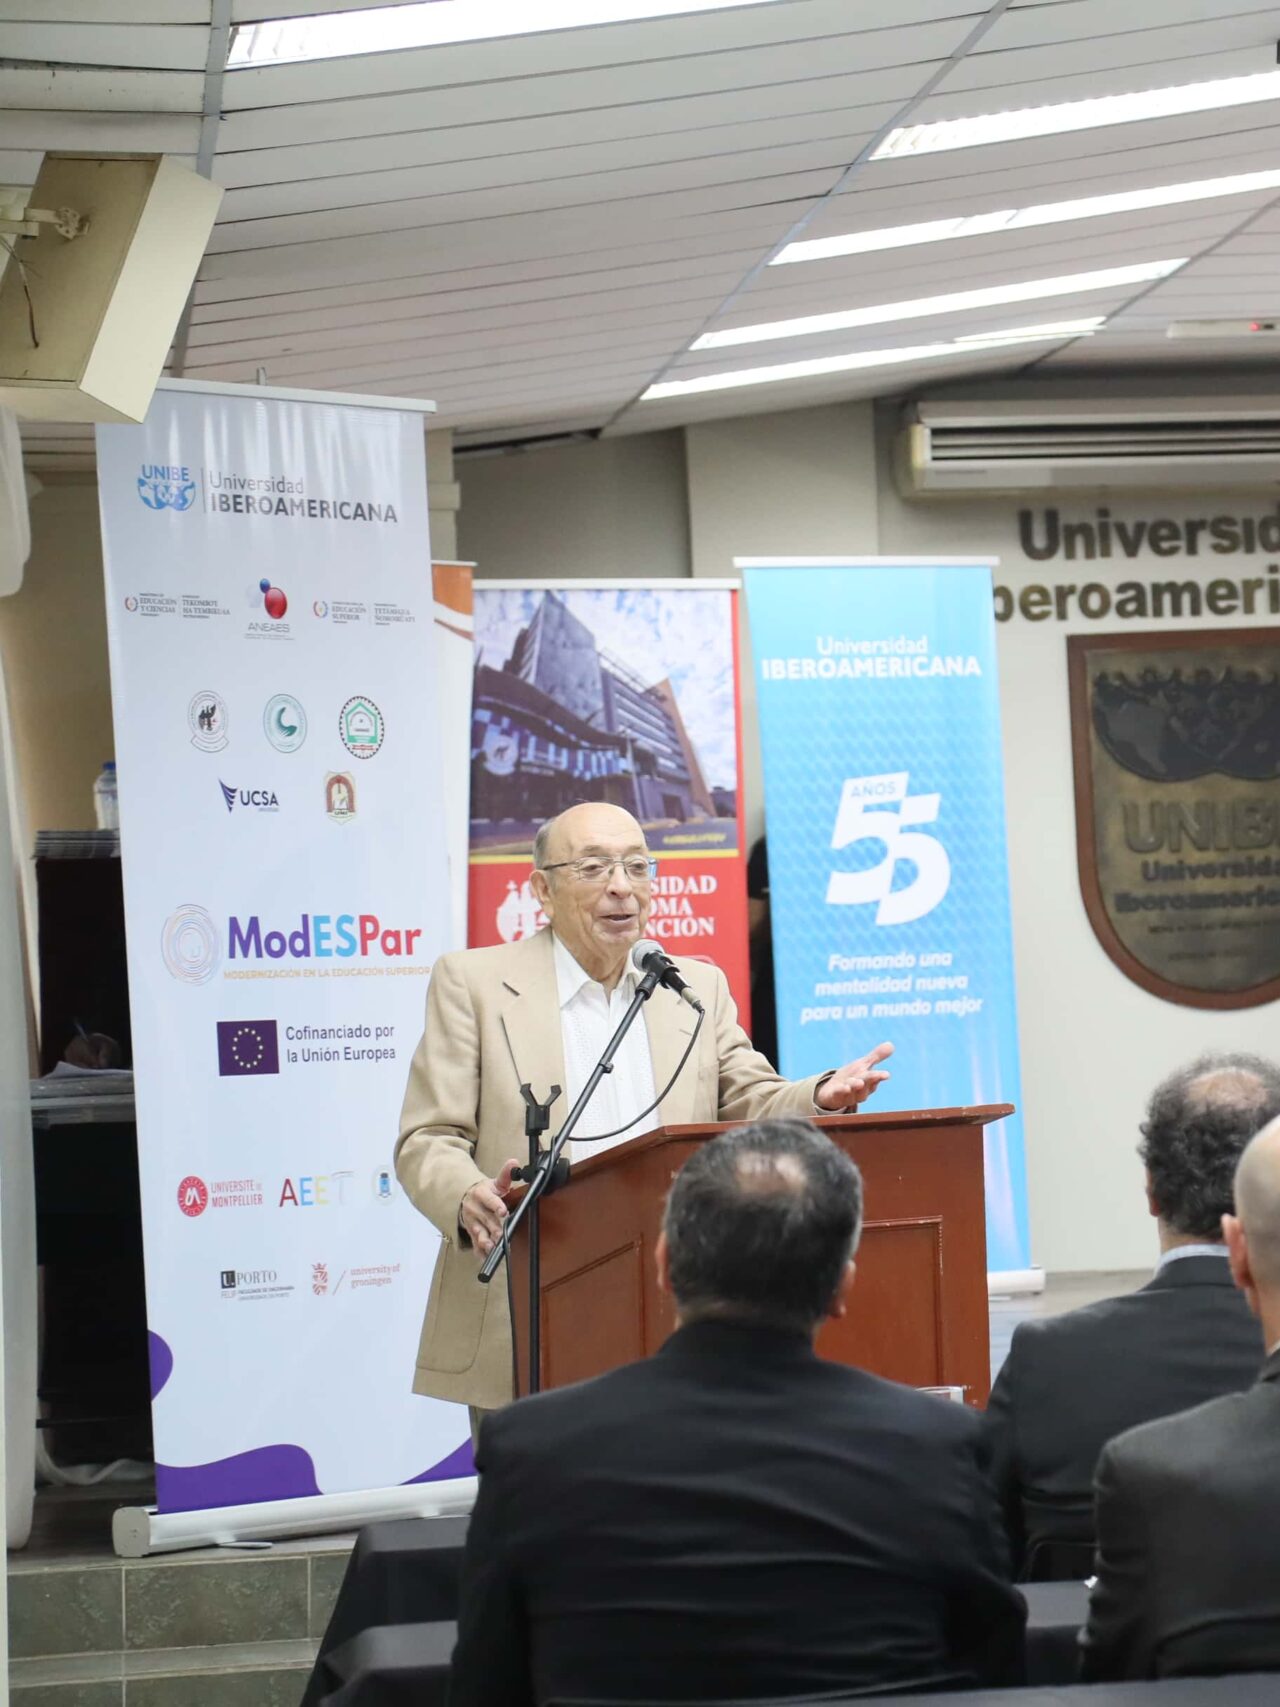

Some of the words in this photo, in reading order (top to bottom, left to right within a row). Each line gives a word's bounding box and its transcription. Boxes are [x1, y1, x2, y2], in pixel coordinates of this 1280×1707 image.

[141, 464, 189, 482] UNIBE
[209, 471, 304, 494] Universidad
[211, 493, 398, 523] IBEROAMERICANA
[247, 622, 290, 633] ANEAES
[816, 635, 929, 656] Universidad
[761, 655, 982, 680] IBEROAMERICANA
[240, 790, 279, 807] UCSA
[850, 780, 897, 798] AÑOS
[228, 914, 422, 959] ModESPar
[828, 951, 917, 973] Formando
[919, 952, 953, 968] una
[303, 968, 316, 978] EN
[318, 968, 330, 977] LA
[332, 966, 384, 977] EDUCACIÓN
[385, 966, 431, 976] SUPERIOR
[815, 975, 912, 997] mentalidad
[915, 976, 969, 991] nueva
[801, 1003, 844, 1024] para
[847, 1003, 869, 1018] un
[872, 997, 931, 1017] mundo
[935, 996, 983, 1018] mejor
[286, 1024, 371, 1041] Cofinanciado
[375, 1024, 395, 1041] por
[287, 1048, 298, 1063] la
[301, 1046, 340, 1063] Unión
[343, 1046, 396, 1062] Europea
[211, 1194, 263, 1208] MONTPELLIER
